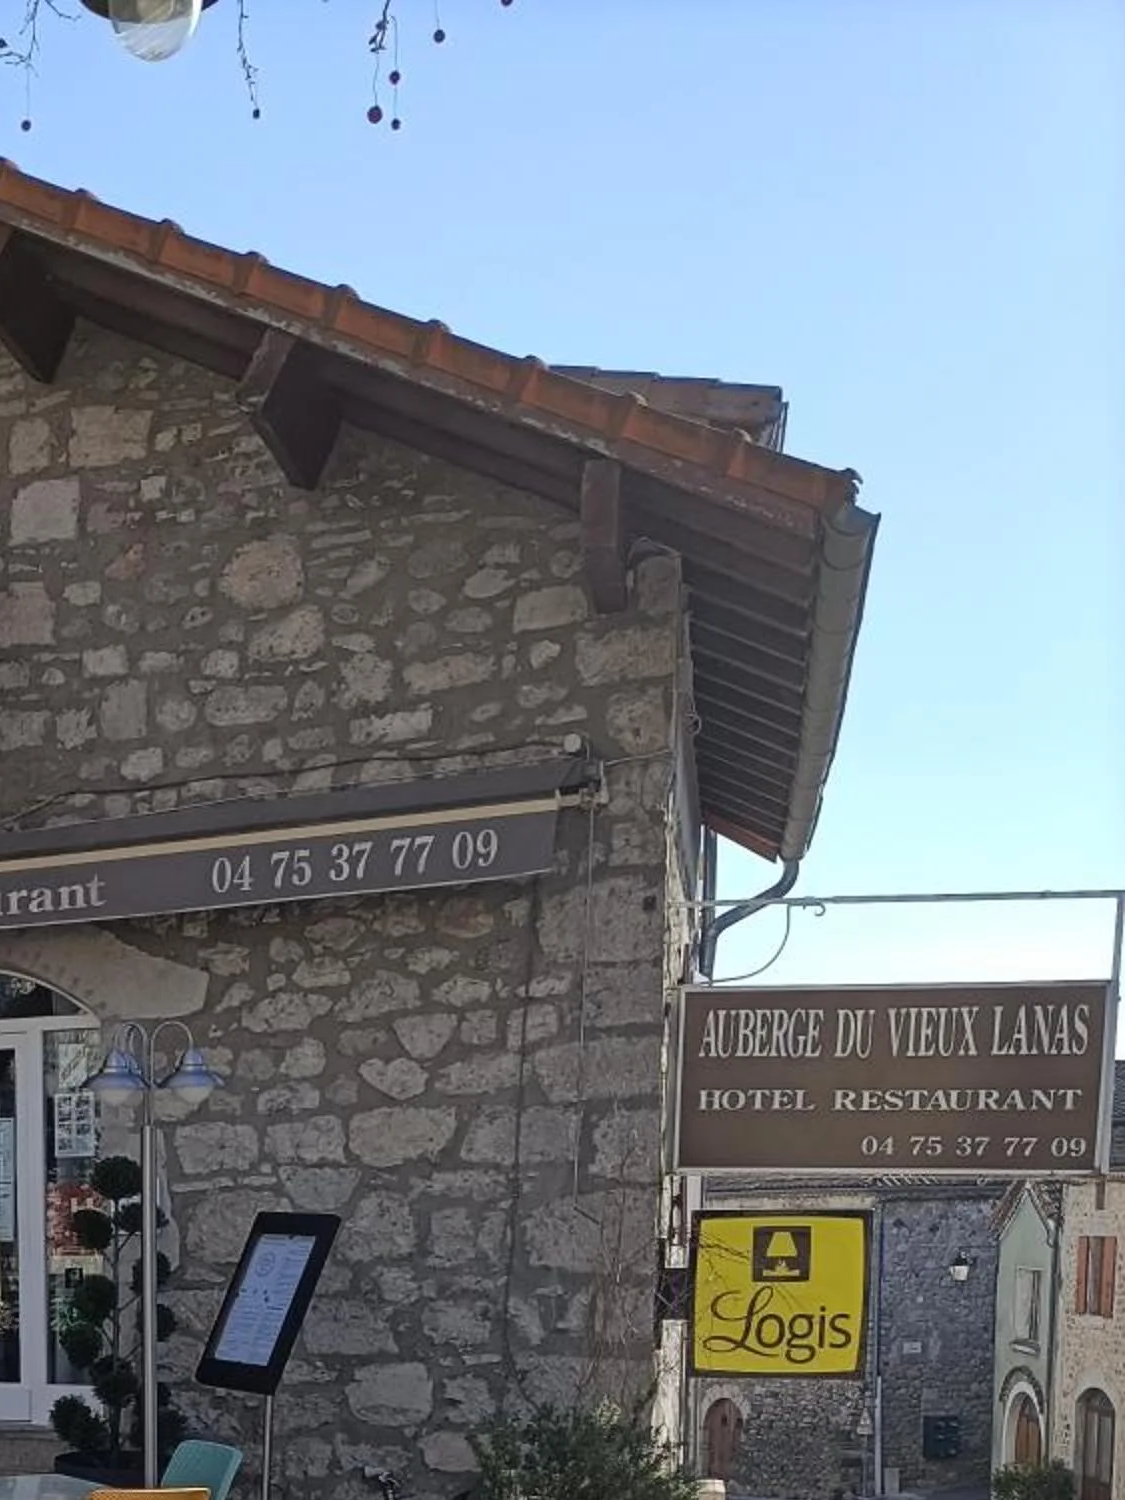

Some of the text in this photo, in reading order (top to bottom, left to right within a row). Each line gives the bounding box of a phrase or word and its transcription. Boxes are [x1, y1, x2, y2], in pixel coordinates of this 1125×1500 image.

[211, 828, 499, 894] 04 75 37 77 09
[699, 1004, 1090, 1058] AUBERGE DU VIEUX LANAS
[698, 1088, 1082, 1112] HOTEL RESTAURANT
[861, 1136, 1086, 1157] 04 75 37 77 09
[703, 1286, 852, 1363] Logis
